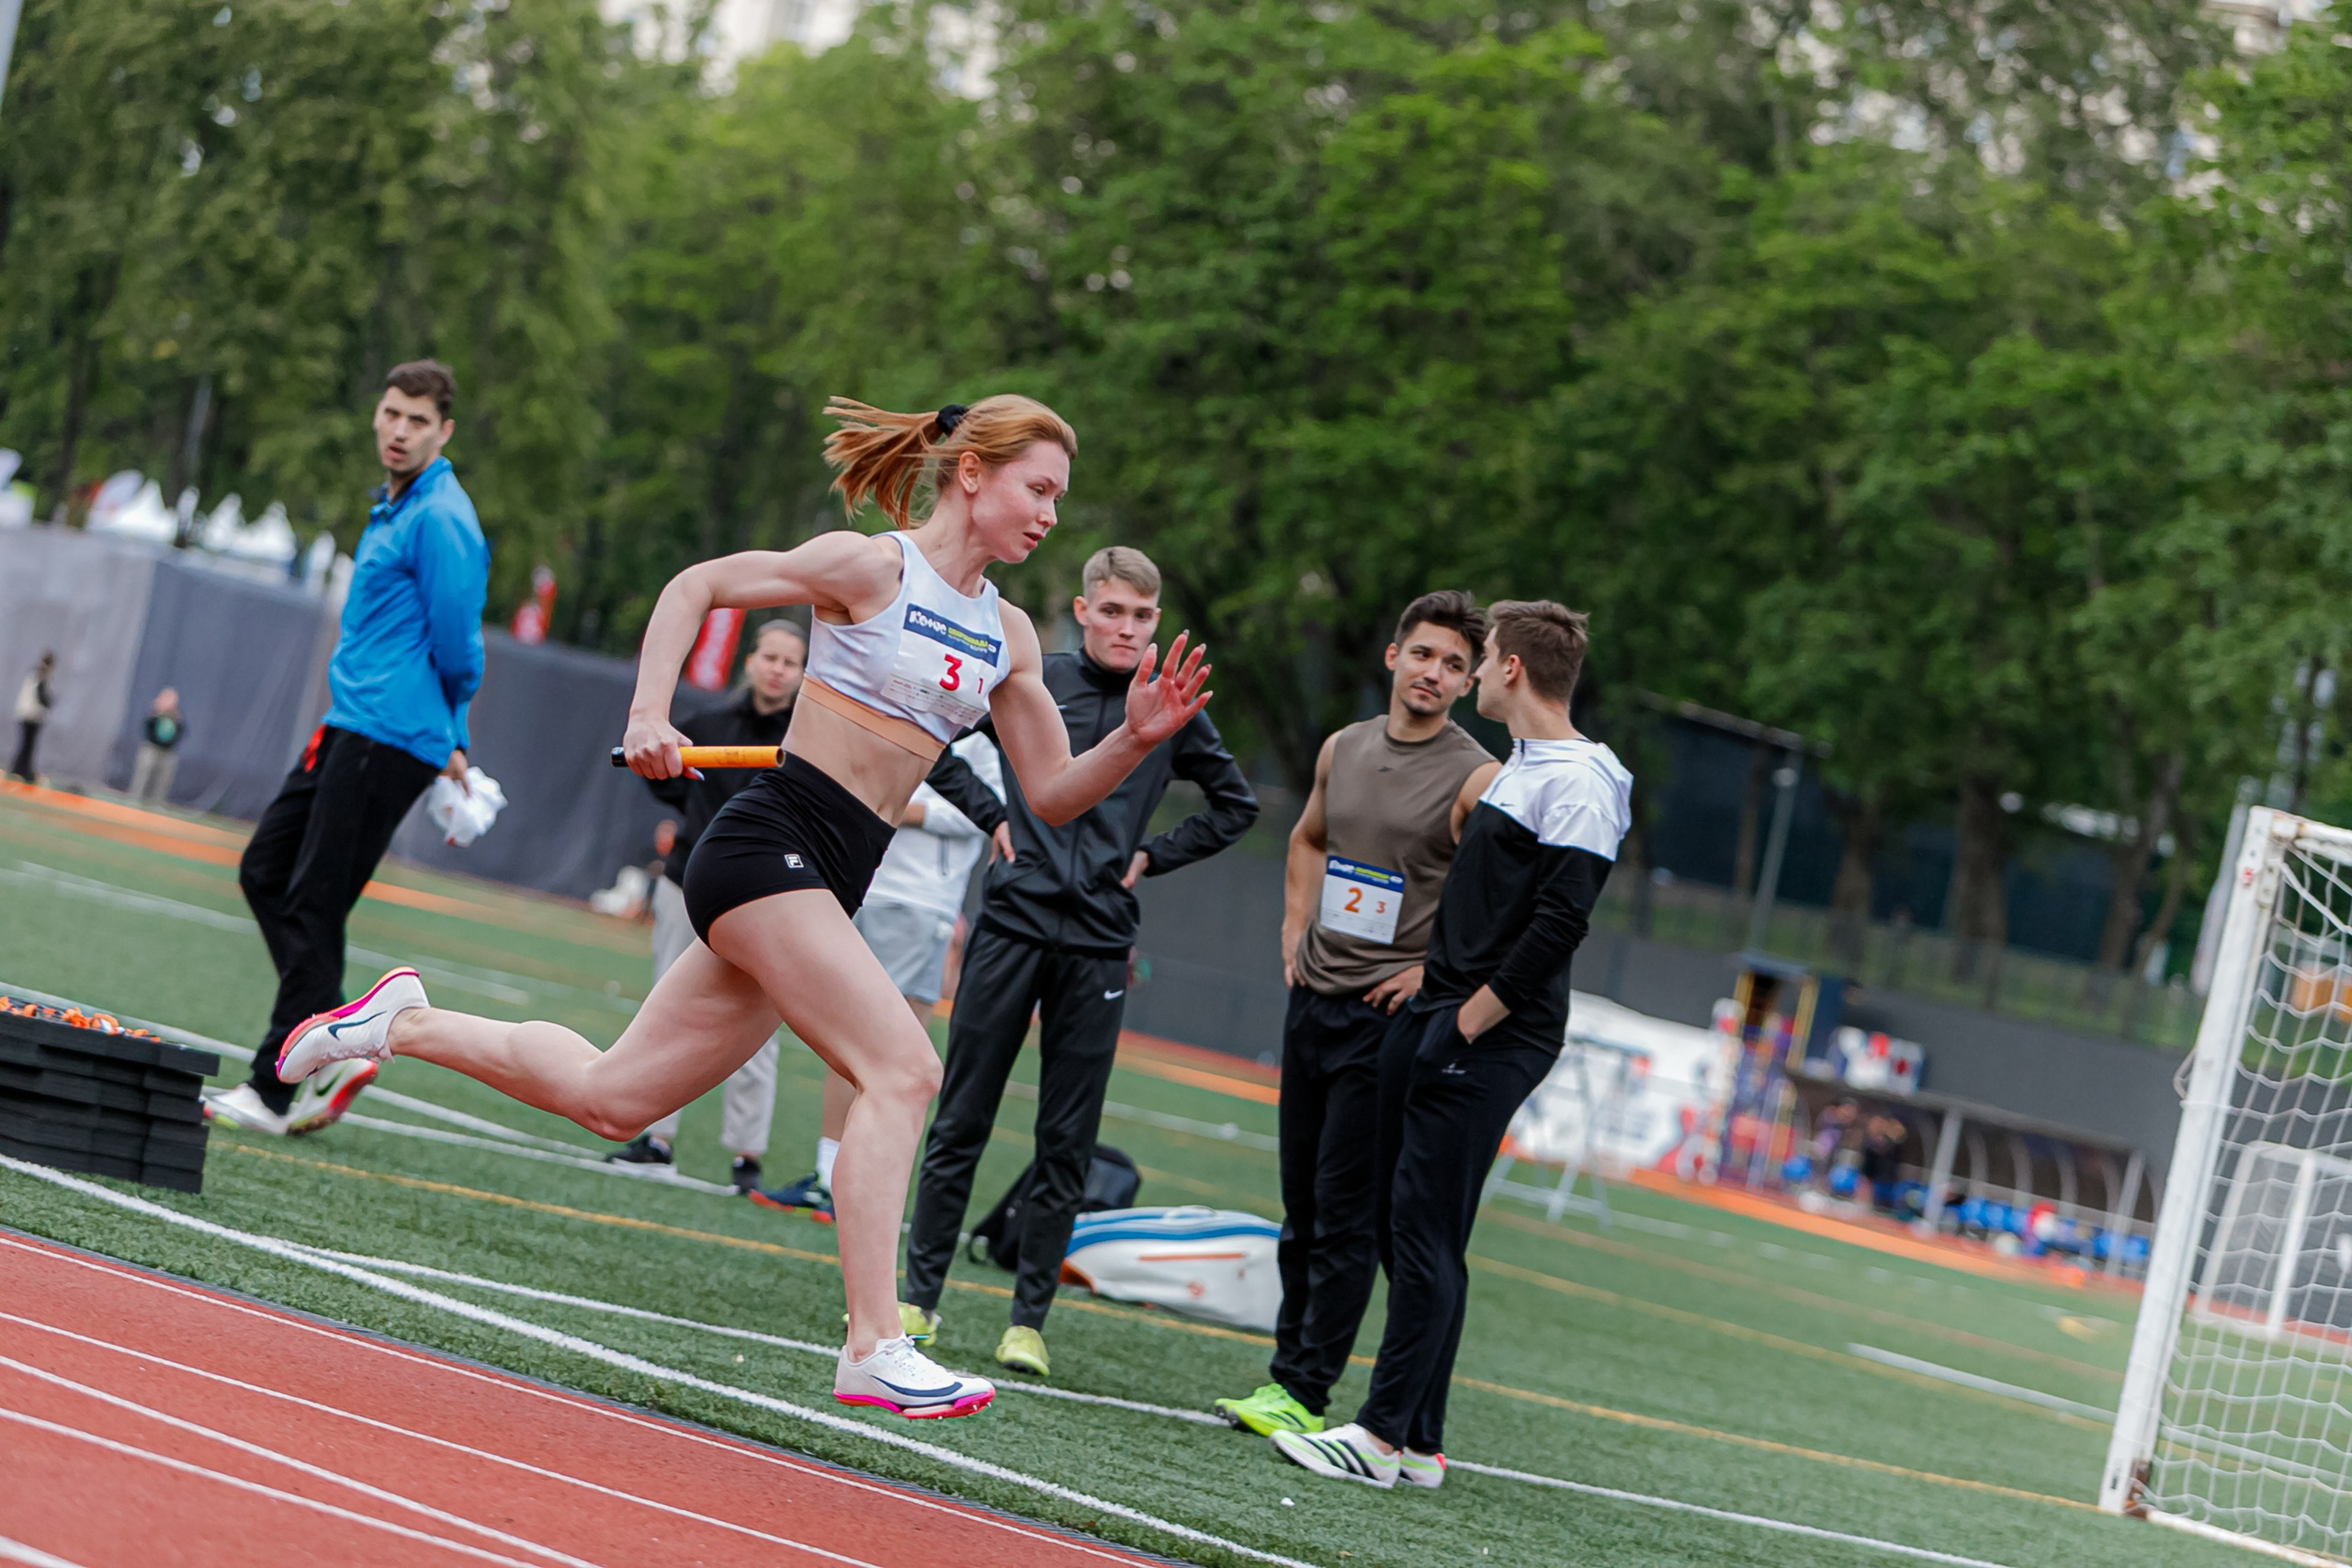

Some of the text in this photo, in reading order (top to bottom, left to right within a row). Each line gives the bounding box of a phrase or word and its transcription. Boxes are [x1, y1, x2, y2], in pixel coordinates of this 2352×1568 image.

[939, 653, 984, 694] 3 1
[1343, 886, 1386, 914] 2 3
